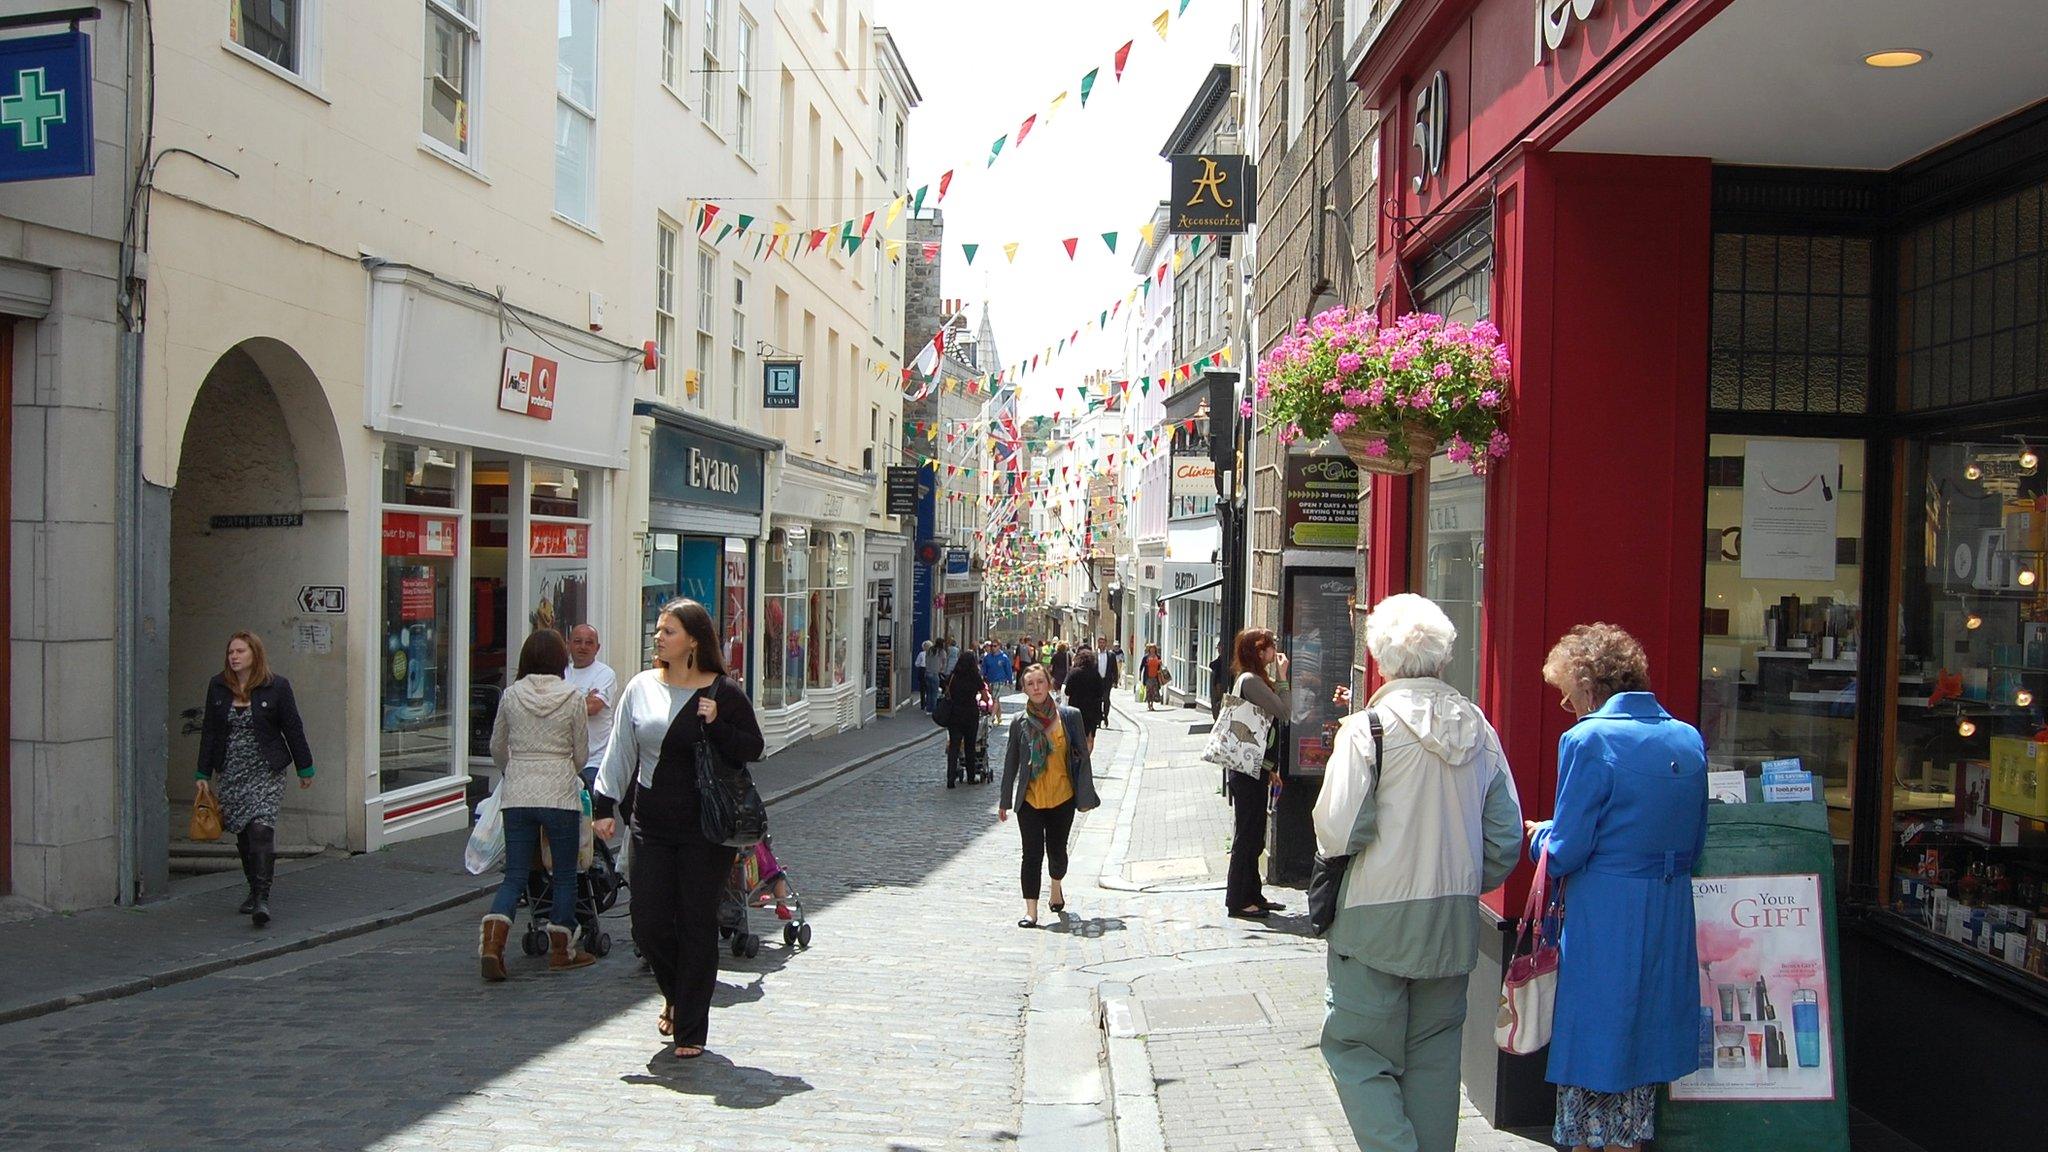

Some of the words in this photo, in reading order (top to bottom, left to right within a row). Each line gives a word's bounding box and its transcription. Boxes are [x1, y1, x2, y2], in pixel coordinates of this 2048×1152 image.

[1412, 70, 1449, 195] 50
[1186, 157, 1233, 208] A
[1178, 213, 1241, 228] Accessorize
[772, 370, 790, 391] E
[767, 397, 796, 405] Evans
[687, 447, 739, 494] Evans
[271, 515, 299, 526] STEPS
